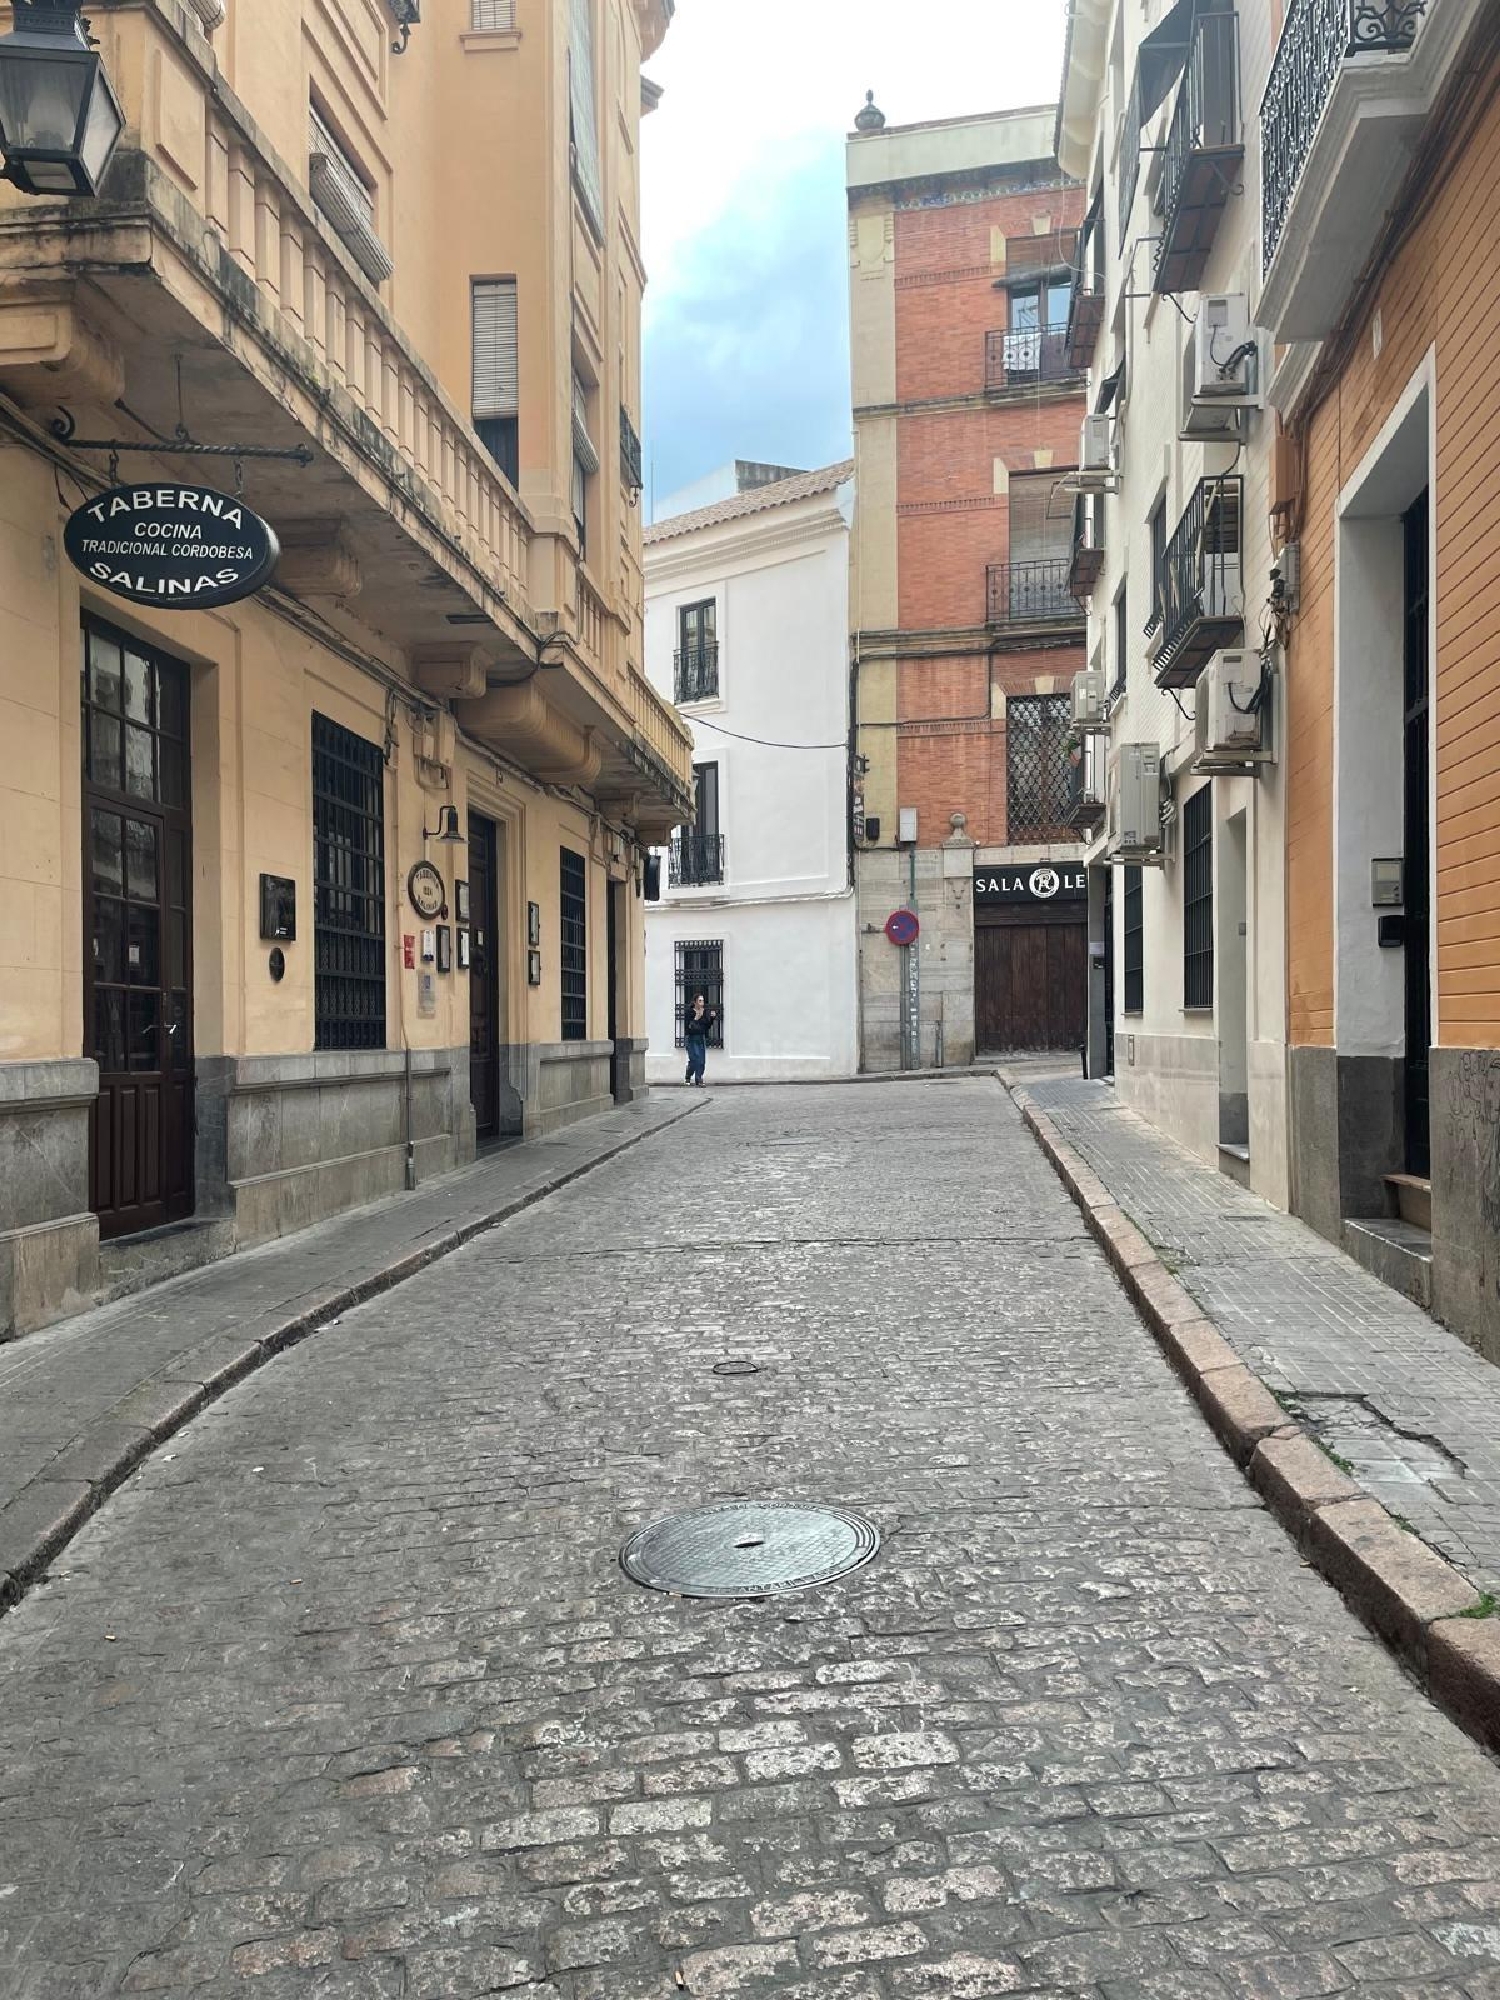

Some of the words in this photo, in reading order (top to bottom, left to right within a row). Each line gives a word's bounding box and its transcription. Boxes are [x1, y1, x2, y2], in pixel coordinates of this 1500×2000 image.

[88, 489, 242, 530] TABERNA
[134, 522, 202, 540] COCINA
[82, 539, 168, 556] TRADICIONAL
[172, 543, 254, 560] CORDOBESA
[89, 562, 239, 594] SALINAS
[975, 877, 1025, 893] SALA
